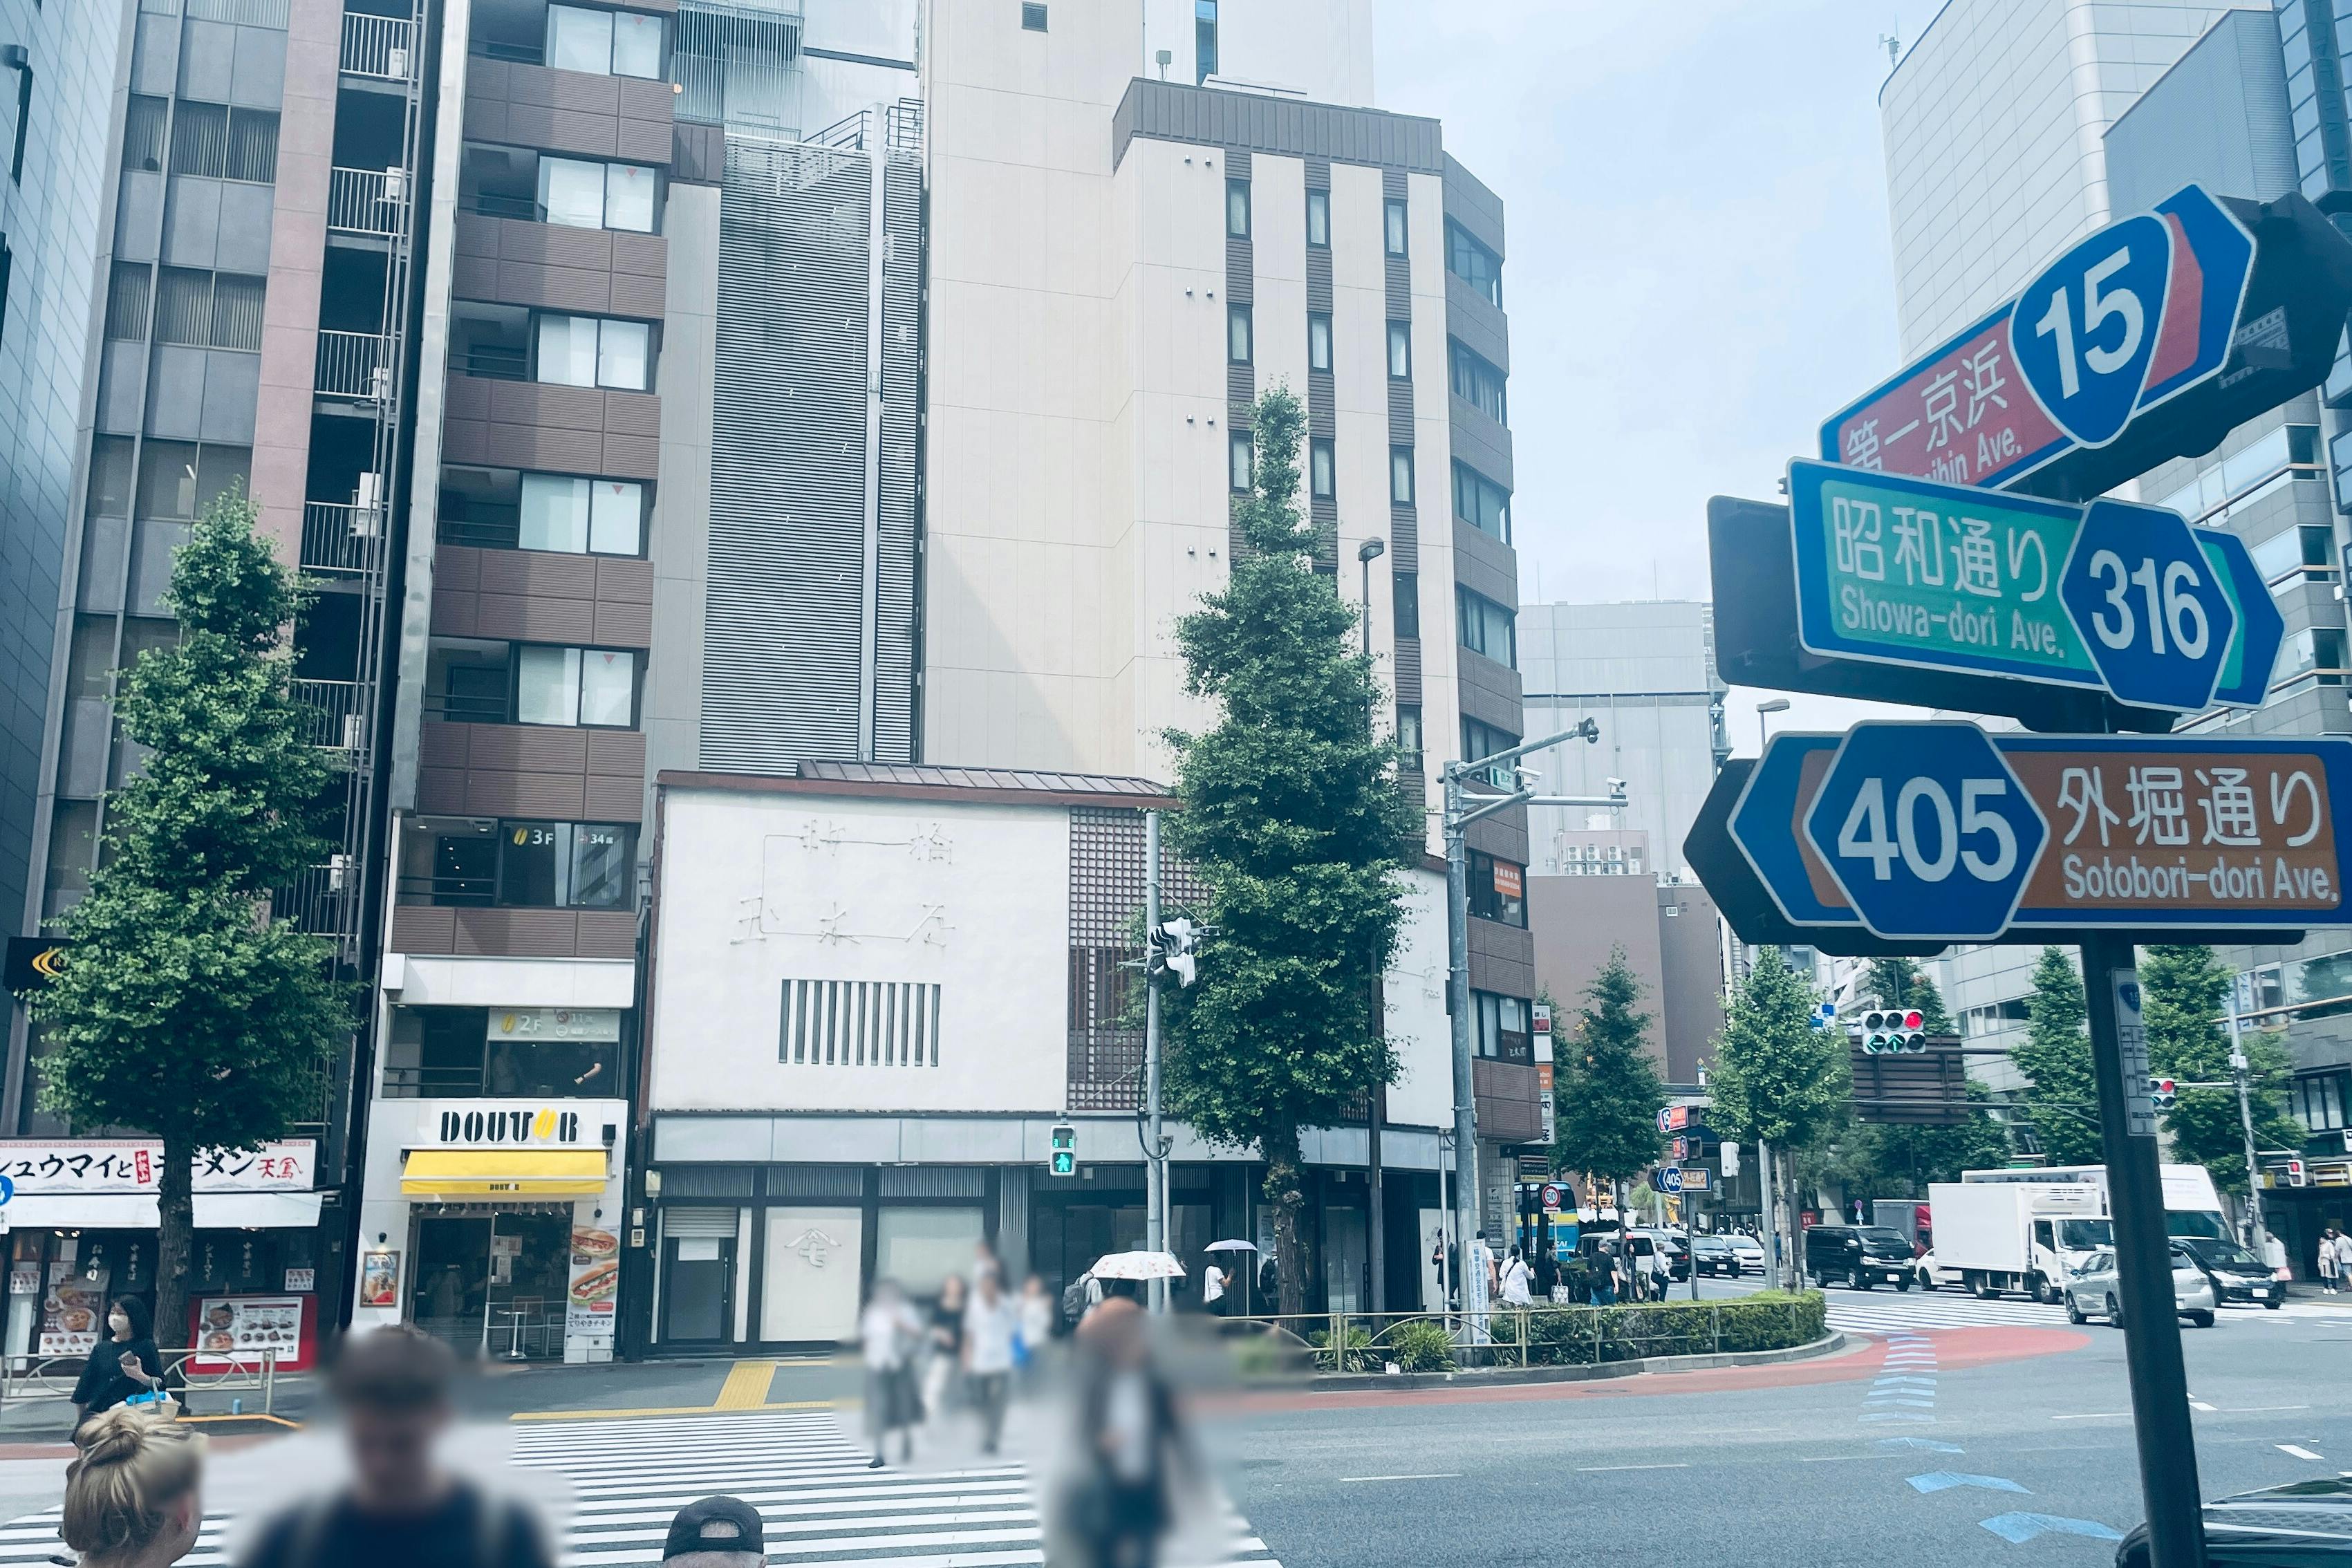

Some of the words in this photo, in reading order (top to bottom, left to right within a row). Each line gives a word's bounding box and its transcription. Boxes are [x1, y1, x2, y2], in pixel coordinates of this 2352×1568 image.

[2036, 245, 2143, 400] 15
[1847, 339, 2008, 471] 第一京浜
[1976, 427, 2022, 472] Ave.
[1832, 496, 2048, 602] 昭和通り
[1840, 584, 1998, 647] Showa-dori
[2010, 609, 2065, 658] Ave.
[2089, 550, 2210, 660] 316
[532, 829, 554, 845] 3F
[1838, 776, 2018, 883] 405
[2056, 766, 2322, 848] 外堀通り
[2064, 853, 2264, 901] Sotobori-dori
[2272, 859, 2339, 902] Ave.
[520, 1015, 543, 1032] 2F
[1546, 1191, 1556, 1201] 50
[1665, 1173, 1681, 1186] 405
